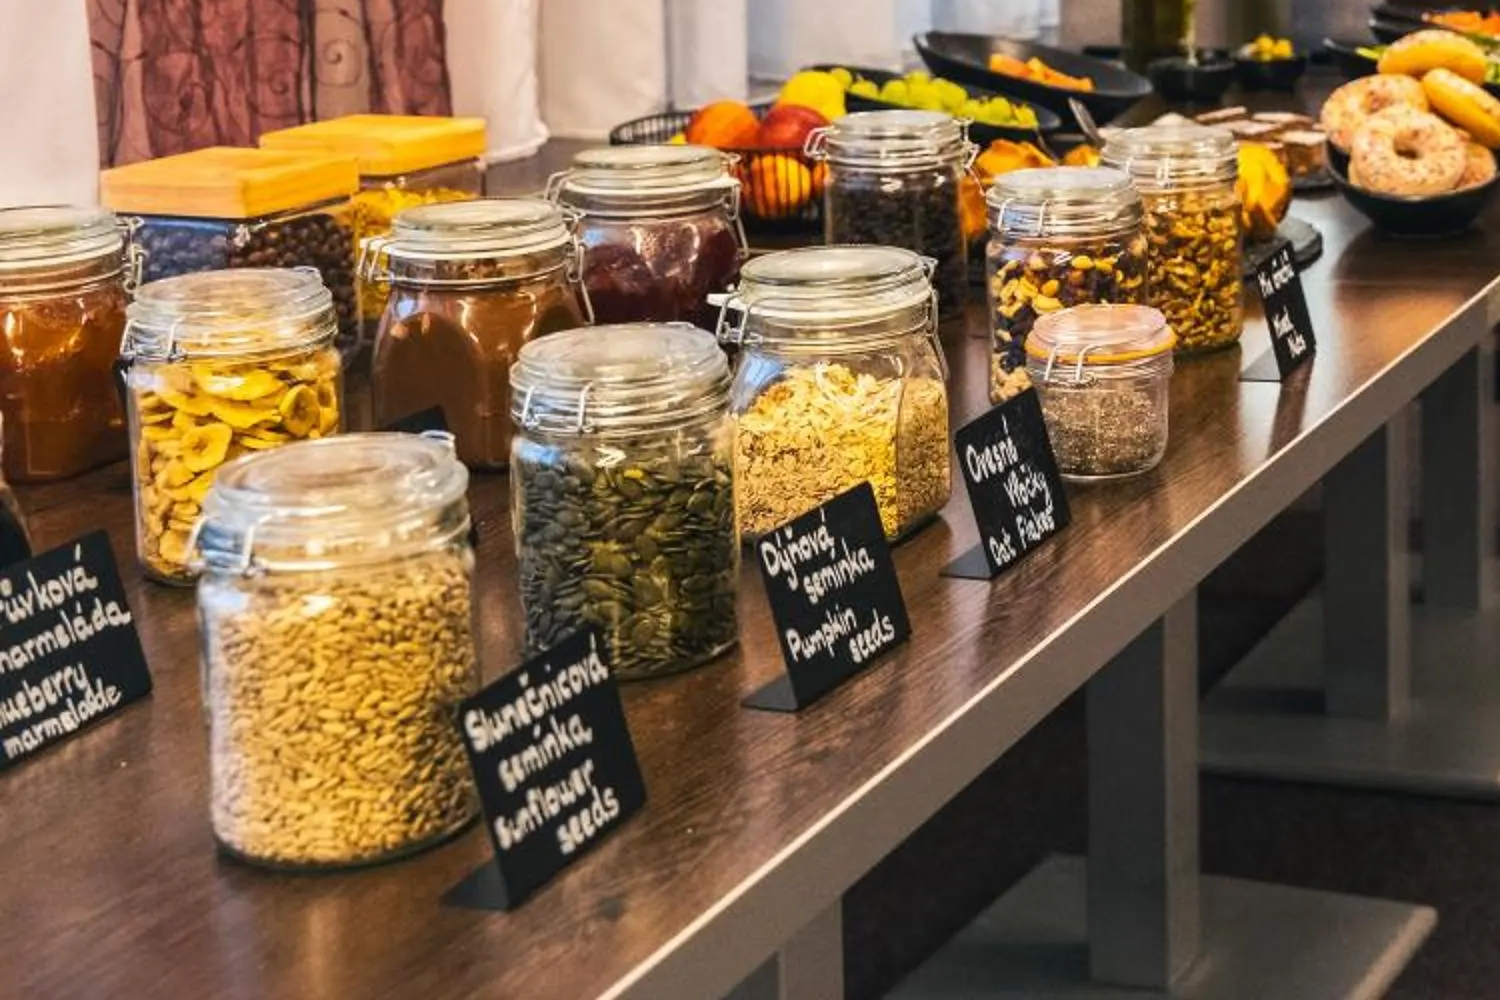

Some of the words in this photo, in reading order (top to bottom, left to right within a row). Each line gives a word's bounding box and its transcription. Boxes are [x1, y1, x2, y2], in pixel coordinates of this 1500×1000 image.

[761, 507, 835, 591] Dýňová
[785, 604, 857, 663] Pumpkin
[849, 608, 895, 663] seeds
[556, 785, 620, 855] seeds
